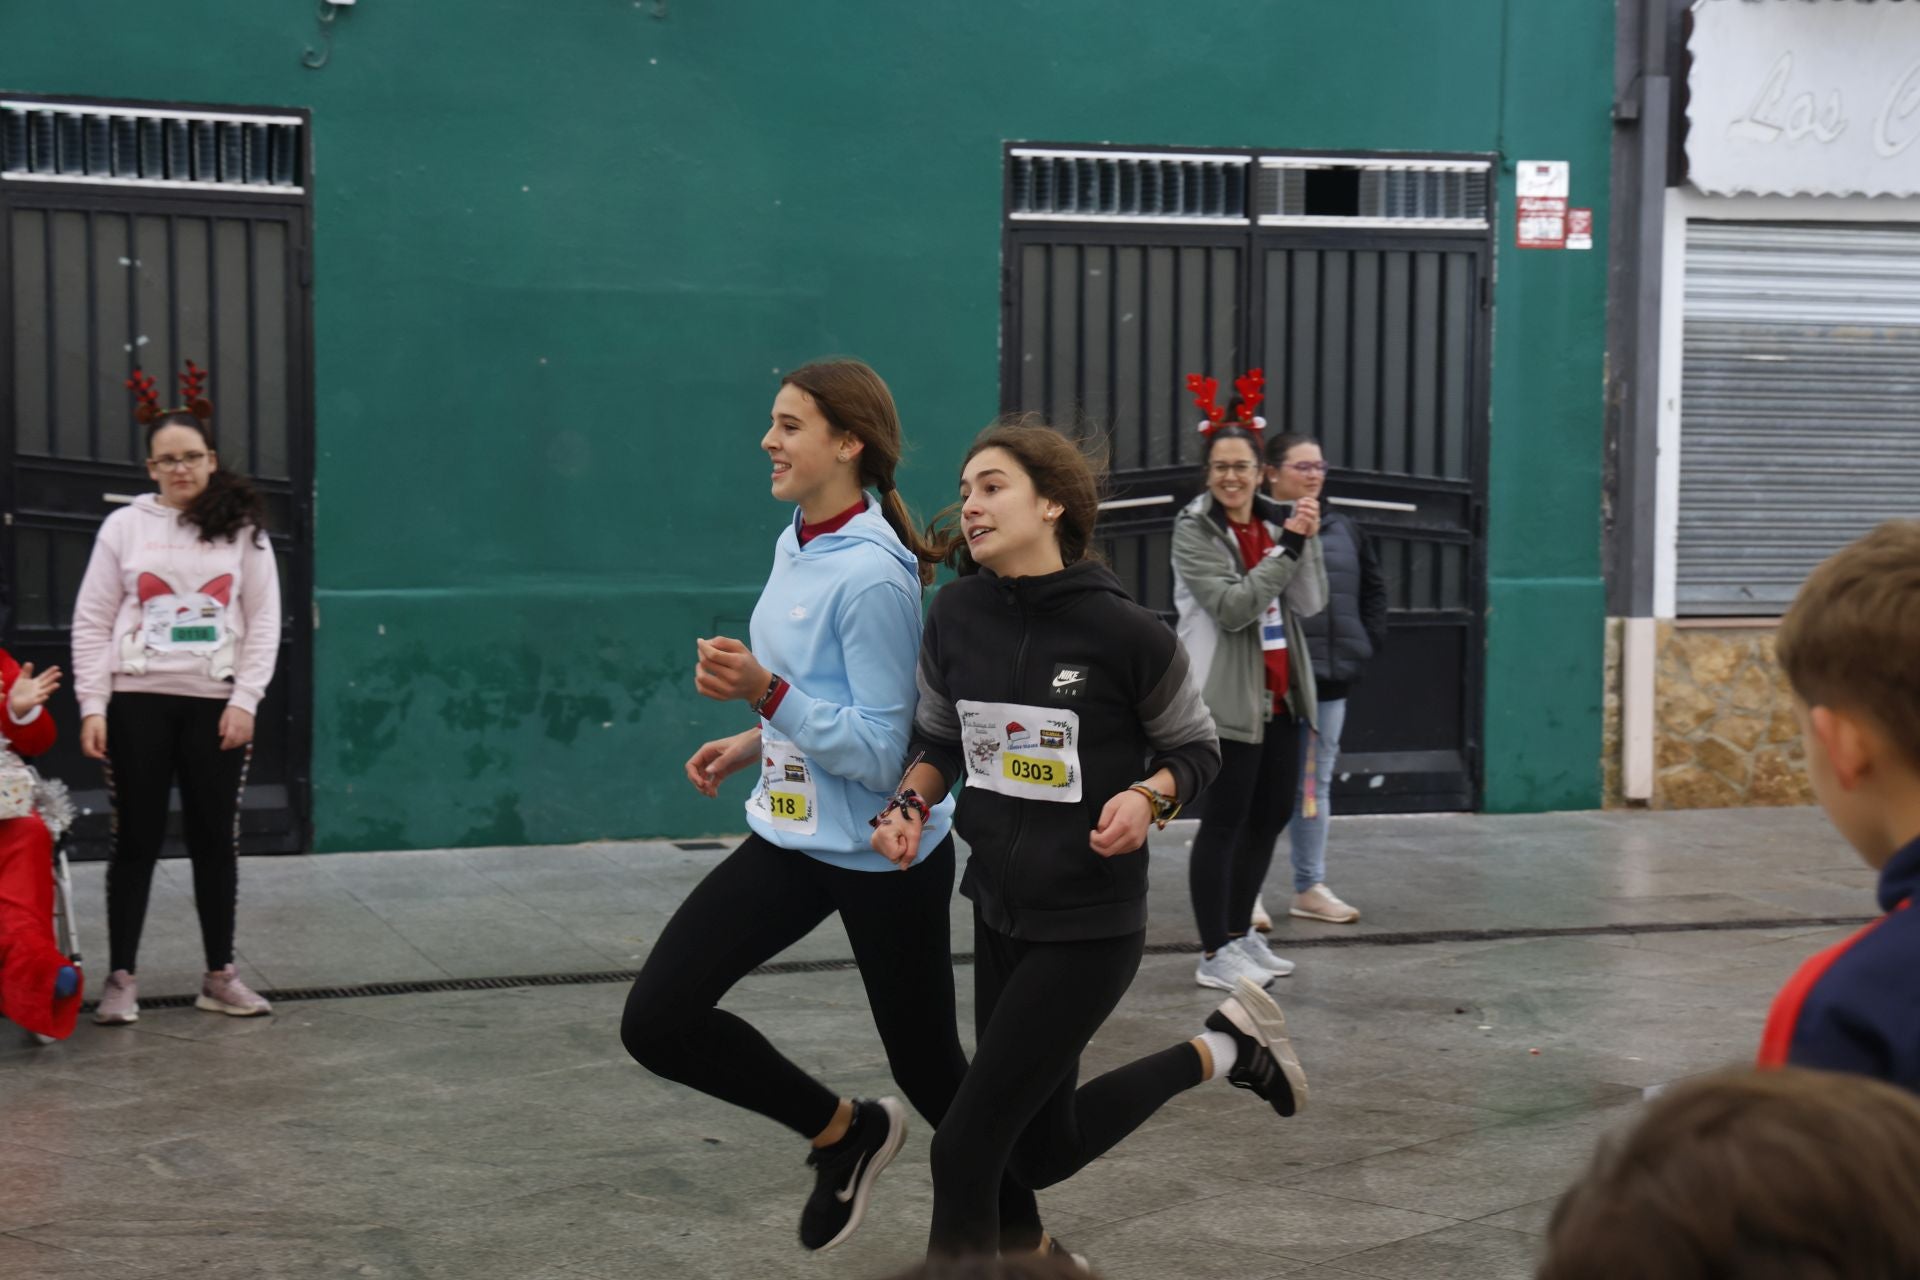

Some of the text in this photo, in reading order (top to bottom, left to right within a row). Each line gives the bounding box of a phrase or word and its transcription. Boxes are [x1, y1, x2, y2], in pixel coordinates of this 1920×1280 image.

[1059, 669, 1080, 680] NIKE
[1055, 687, 1077, 696] AIR
[1012, 759, 1053, 781] 0303
